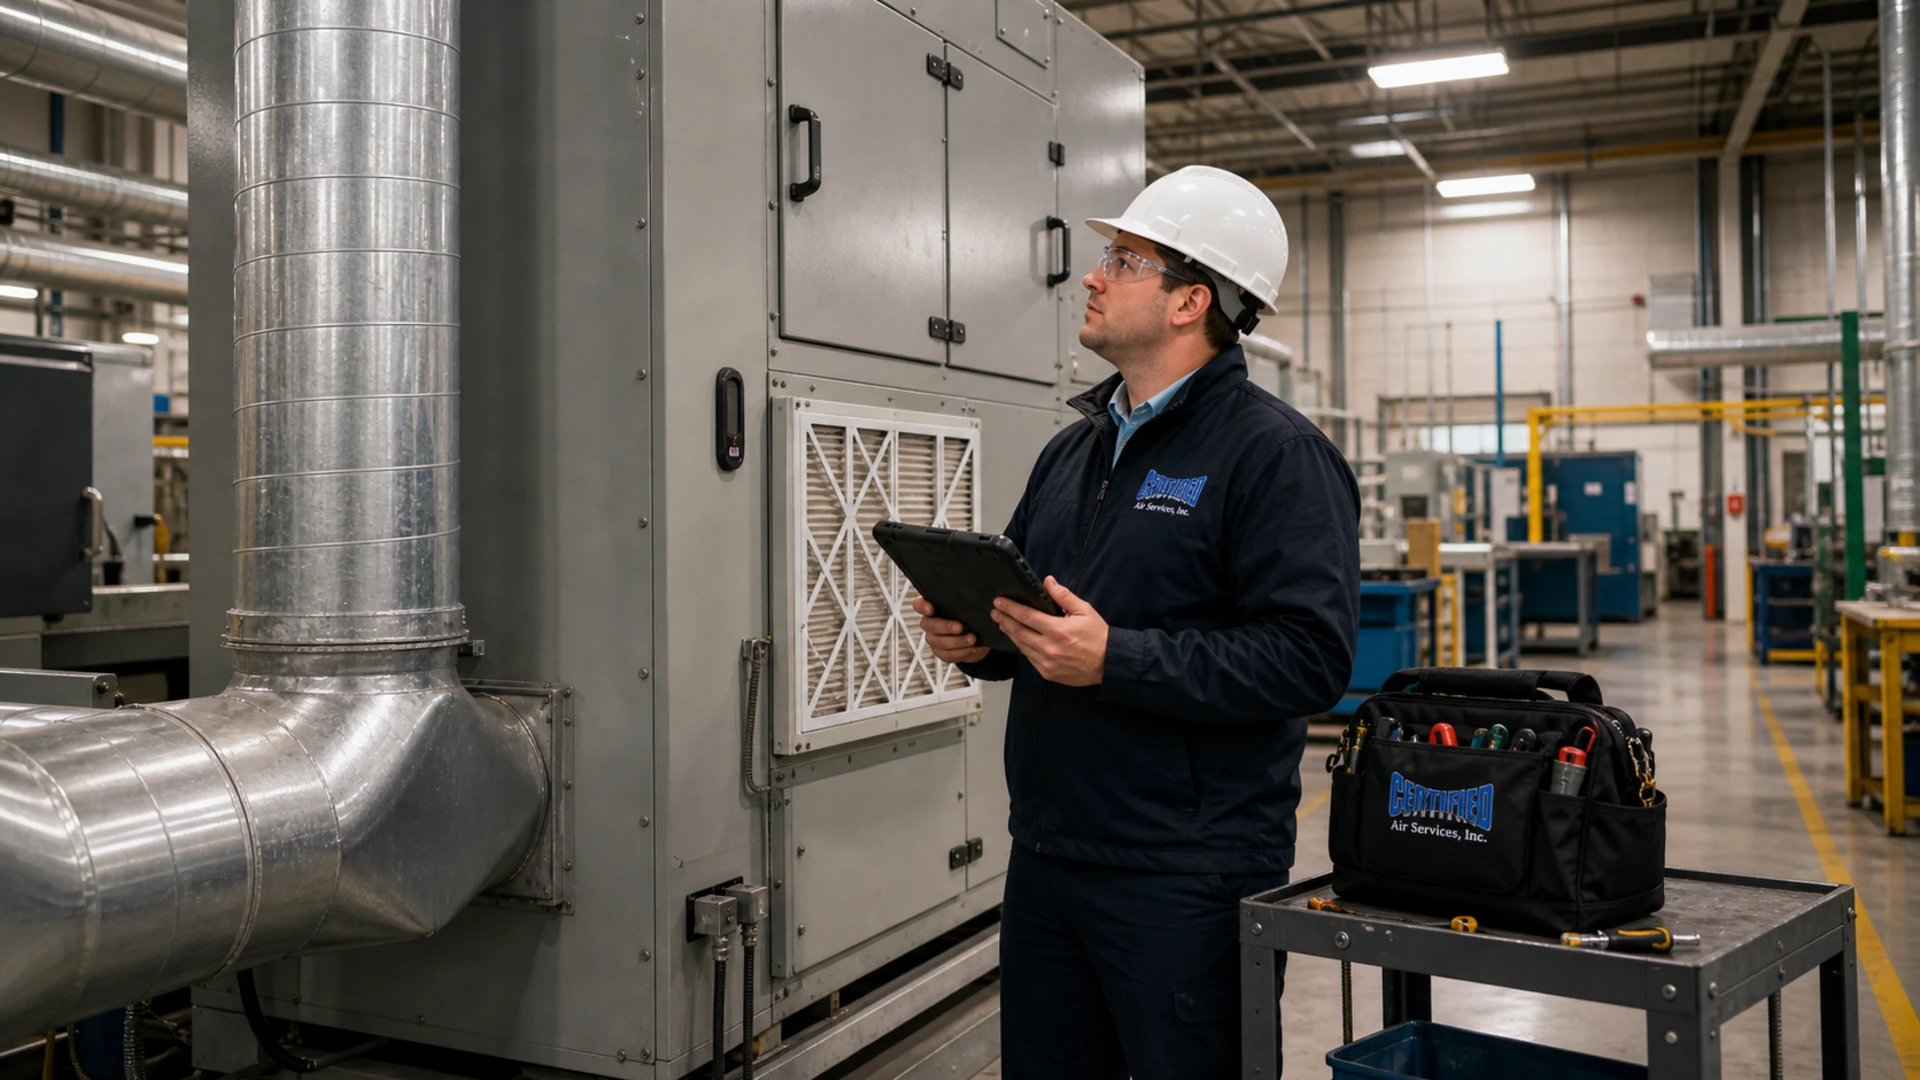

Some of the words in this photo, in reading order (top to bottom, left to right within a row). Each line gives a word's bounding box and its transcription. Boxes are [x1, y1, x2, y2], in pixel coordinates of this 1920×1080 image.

[1133, 502, 1146, 510] Air
[1146, 502, 1175, 516] Services,
[1176, 506, 1189, 516] Inc.
[1389, 771, 1494, 831] CERTIFIED
[1390, 820, 1408, 831] Air
[1411, 822, 1461, 841] Services,
[1465, 829, 1487, 843] Inc.
